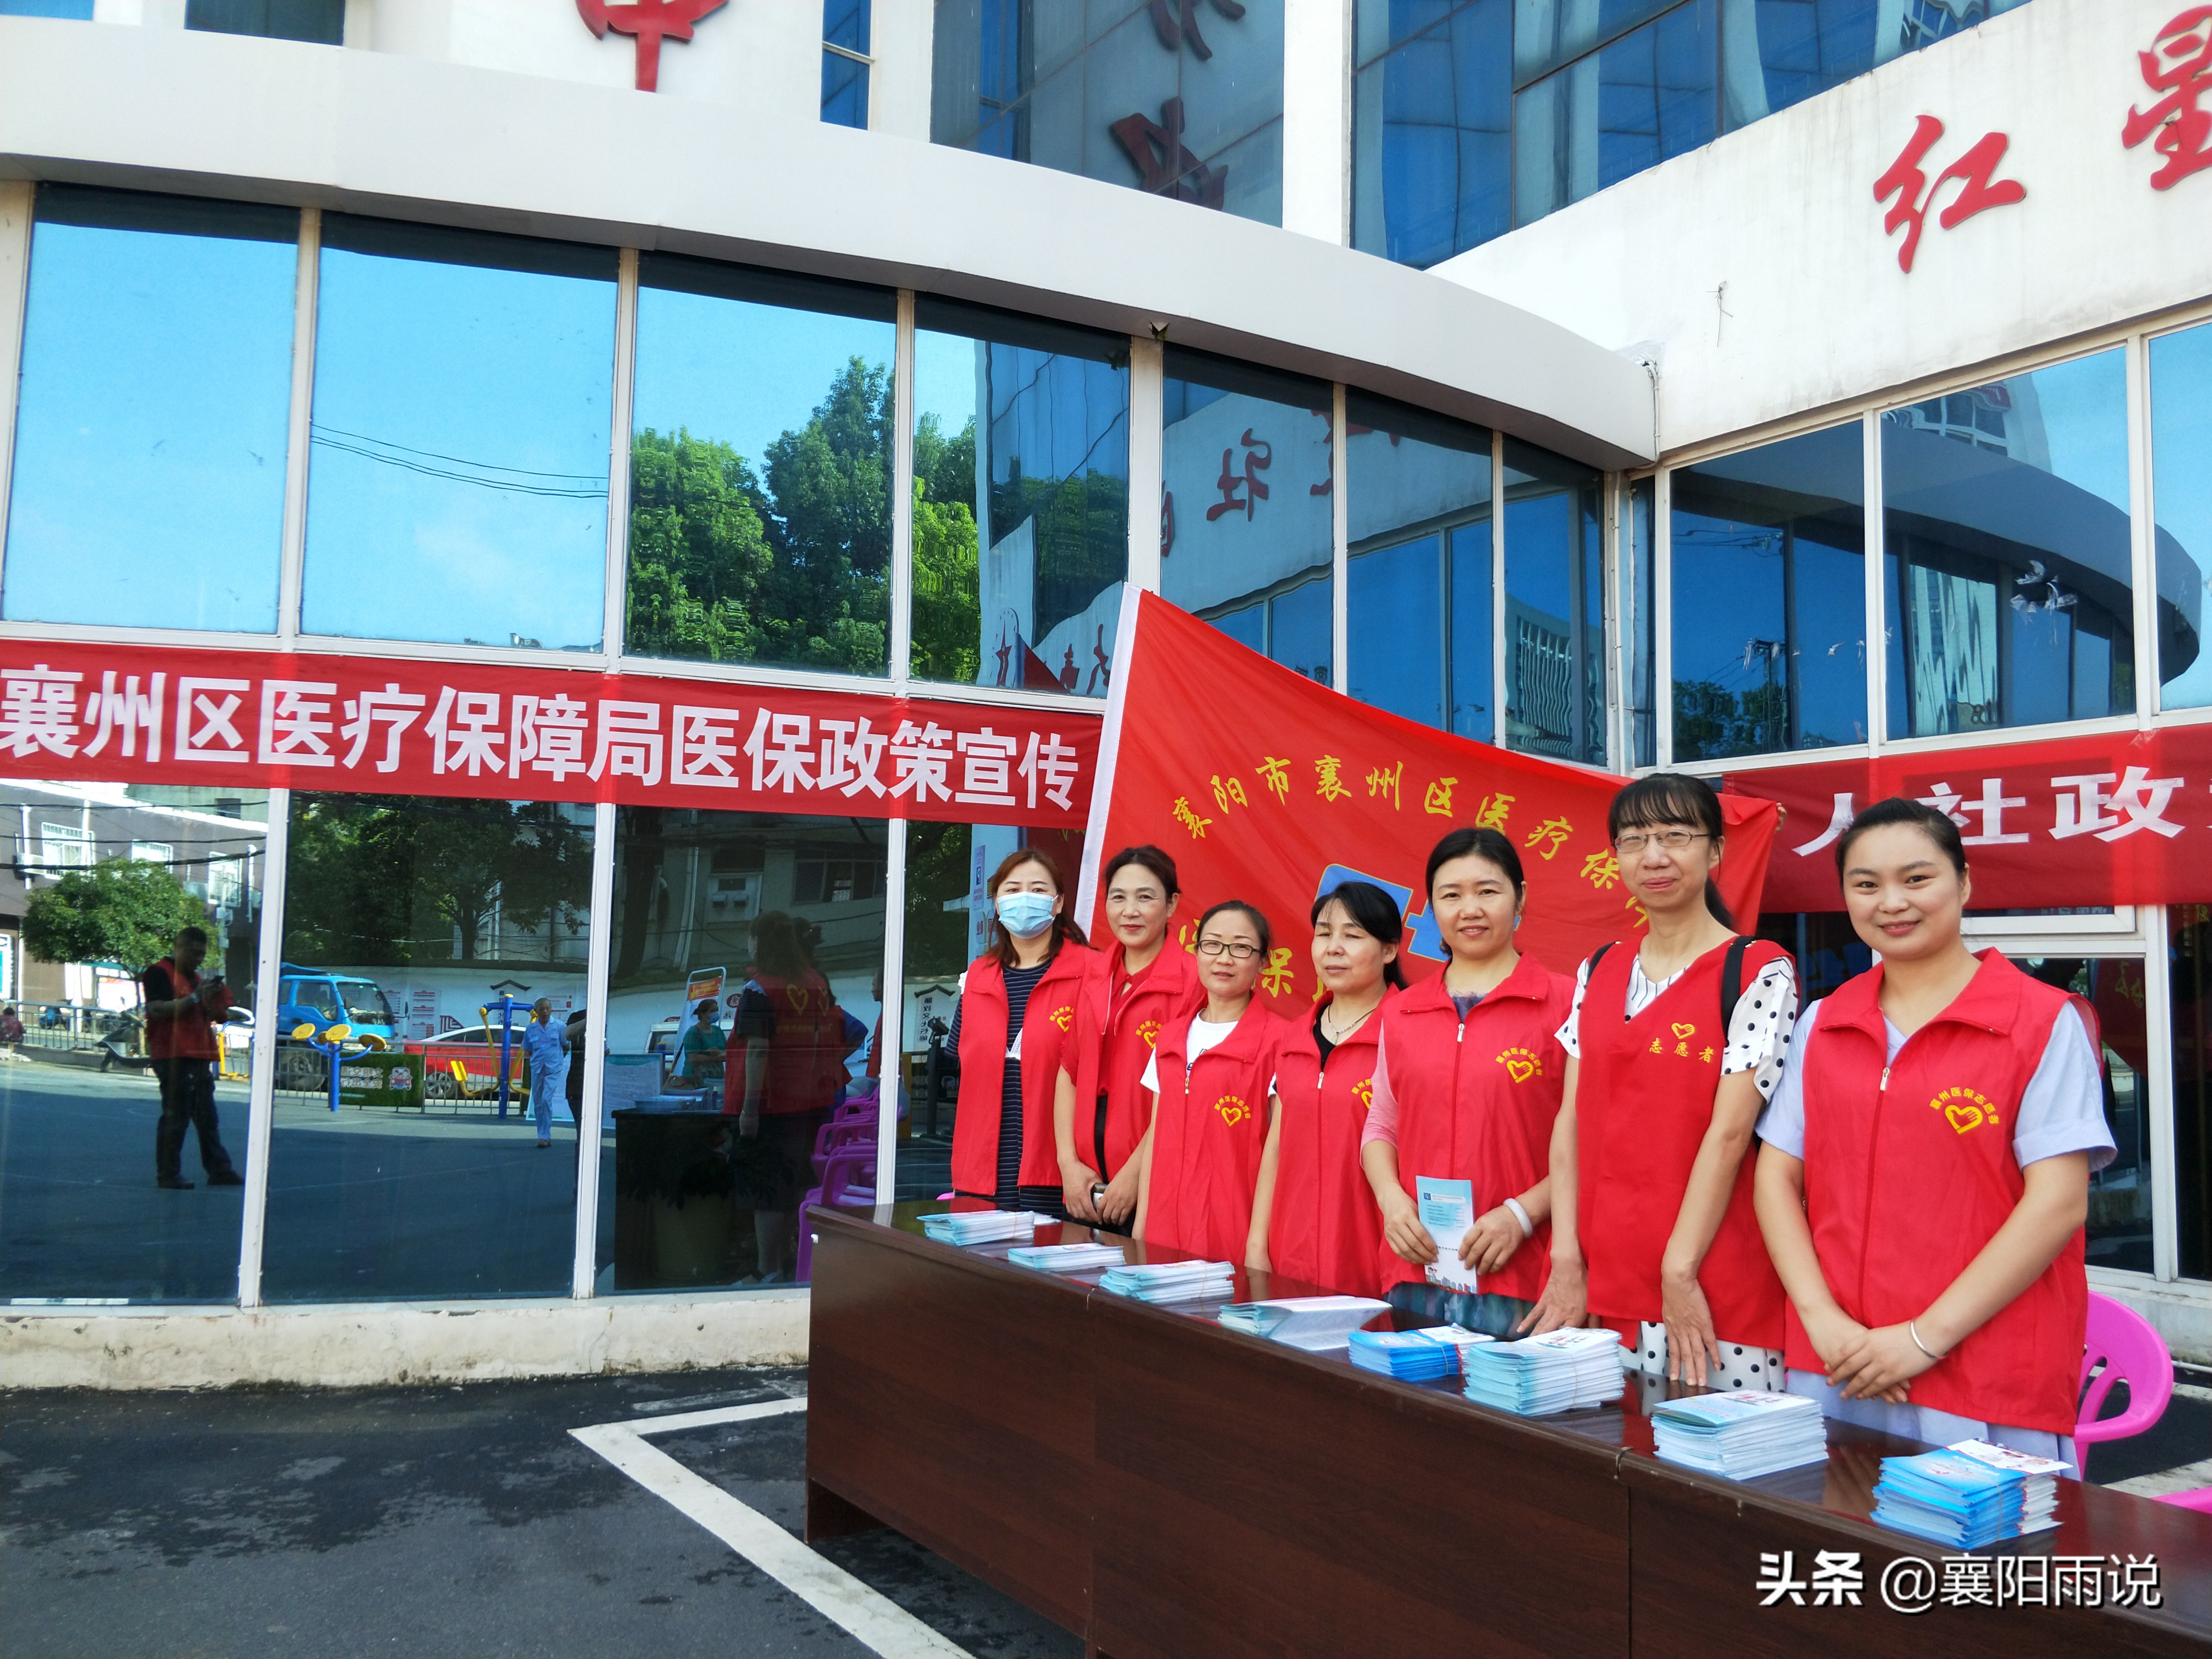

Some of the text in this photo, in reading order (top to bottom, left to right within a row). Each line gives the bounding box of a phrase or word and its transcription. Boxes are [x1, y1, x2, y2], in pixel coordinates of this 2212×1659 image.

[0, 663, 1079, 812] 襄州区医疗保障局医保政策宣传
[1649, 1037, 1714, 1063] 志愿者
[1929, 1086, 2000, 1125] 襄州医保志愿者
